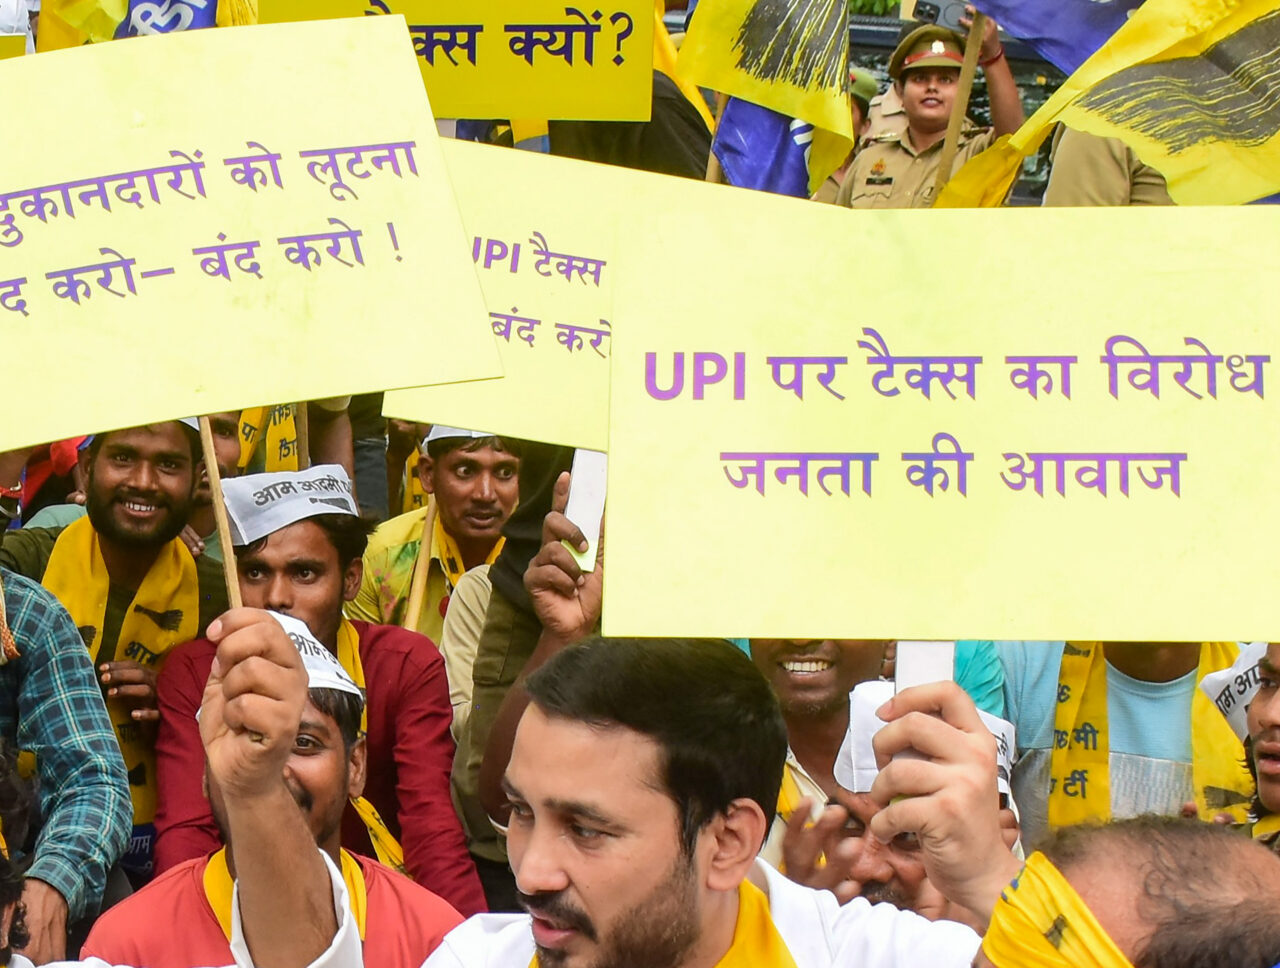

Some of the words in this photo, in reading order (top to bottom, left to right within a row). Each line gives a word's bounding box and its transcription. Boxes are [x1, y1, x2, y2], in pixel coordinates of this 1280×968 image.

[409, 24, 484, 67] क्स
[504, 7, 633, 67] क्यों?
[223, 141, 283, 192] को
[298, 141, 419, 202] लूटना
[192, 232, 261, 282] बंद
[528, 230, 608, 288] टैक्स
[488, 306, 542, 349] बंद
[644, 351, 747, 401] UPI
[766, 355, 848, 400] पर
[857, 327, 983, 400] टैक्स
[1005, 355, 1078, 400] का
[1100, 335, 1271, 401] विरोध
[252, 479, 299, 508] आम
[720, 452, 880, 498] जनता
[901, 432, 975, 498] की
[1000, 452, 1189, 499] आवाज
